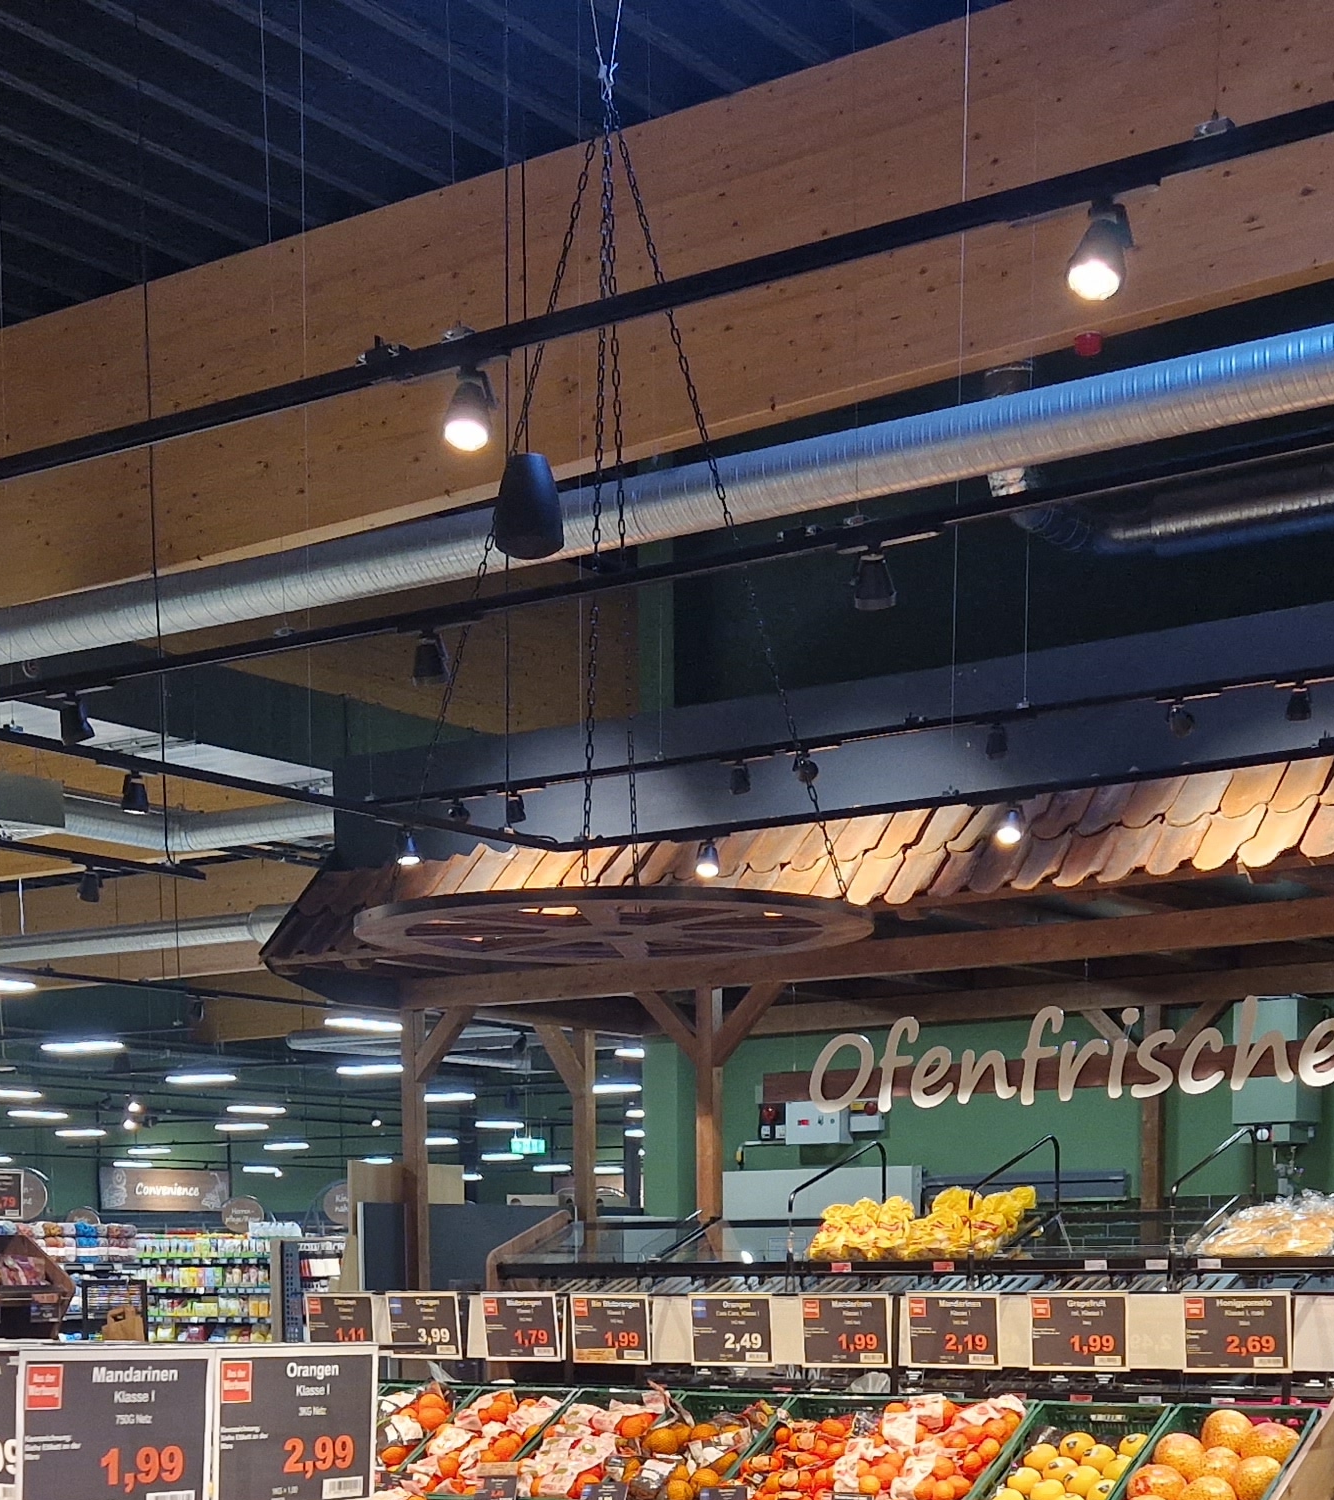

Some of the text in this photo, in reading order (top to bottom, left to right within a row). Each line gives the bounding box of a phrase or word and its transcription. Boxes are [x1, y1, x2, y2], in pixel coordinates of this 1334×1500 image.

[135, 1182, 200, 1197] Convenience
[417, 1327, 451, 1345] 3,99
[514, 1329, 548, 1346] 1,79
[604, 1330, 640, 1349] 1,99
[723, 1331, 763, 1353] 2,49
[838, 1332, 879, 1354] 1,99
[944, 1332, 989, 1354] 2,19
[1070, 1334, 1115, 1355] 1,99
[1225, 1335, 1276, 1355] 2,69
[92, 1365, 179, 1384] Mandarinen
[286, 1361, 340, 1380] Orangen
[114, 1390, 149, 1404] Klasse
[296, 1384, 325, 1397] Klasse
[282, 1434, 355, 1480] 2,99
[99, 1445, 185, 1494] 1,99
